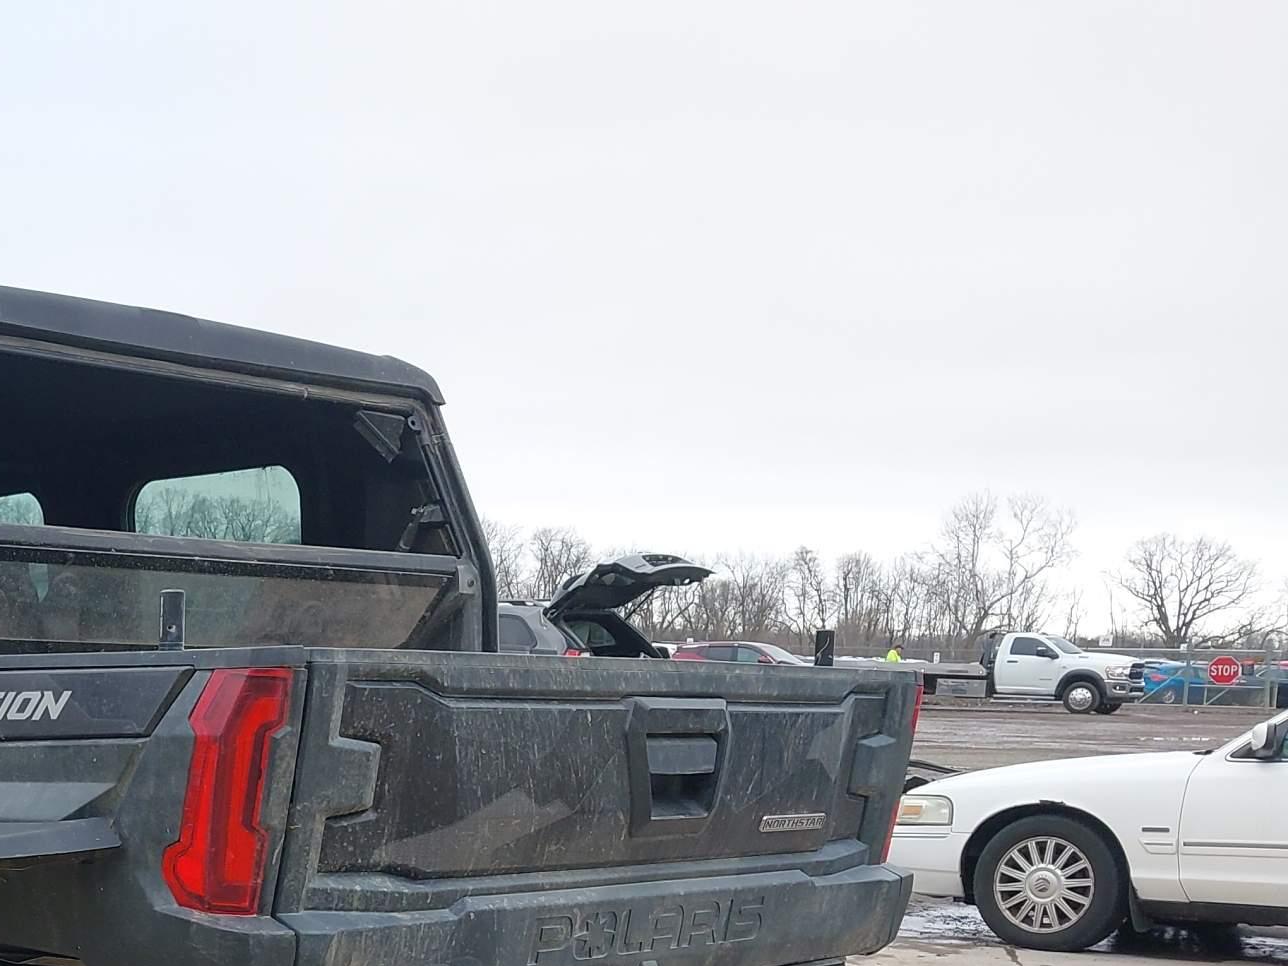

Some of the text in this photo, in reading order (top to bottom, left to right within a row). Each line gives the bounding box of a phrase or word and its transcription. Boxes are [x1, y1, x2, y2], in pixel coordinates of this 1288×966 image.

[1211, 665, 1238, 676] STOP
[764, 816, 824, 829] NORTHSTAR
[526, 896, 764, 966] POLARIS
